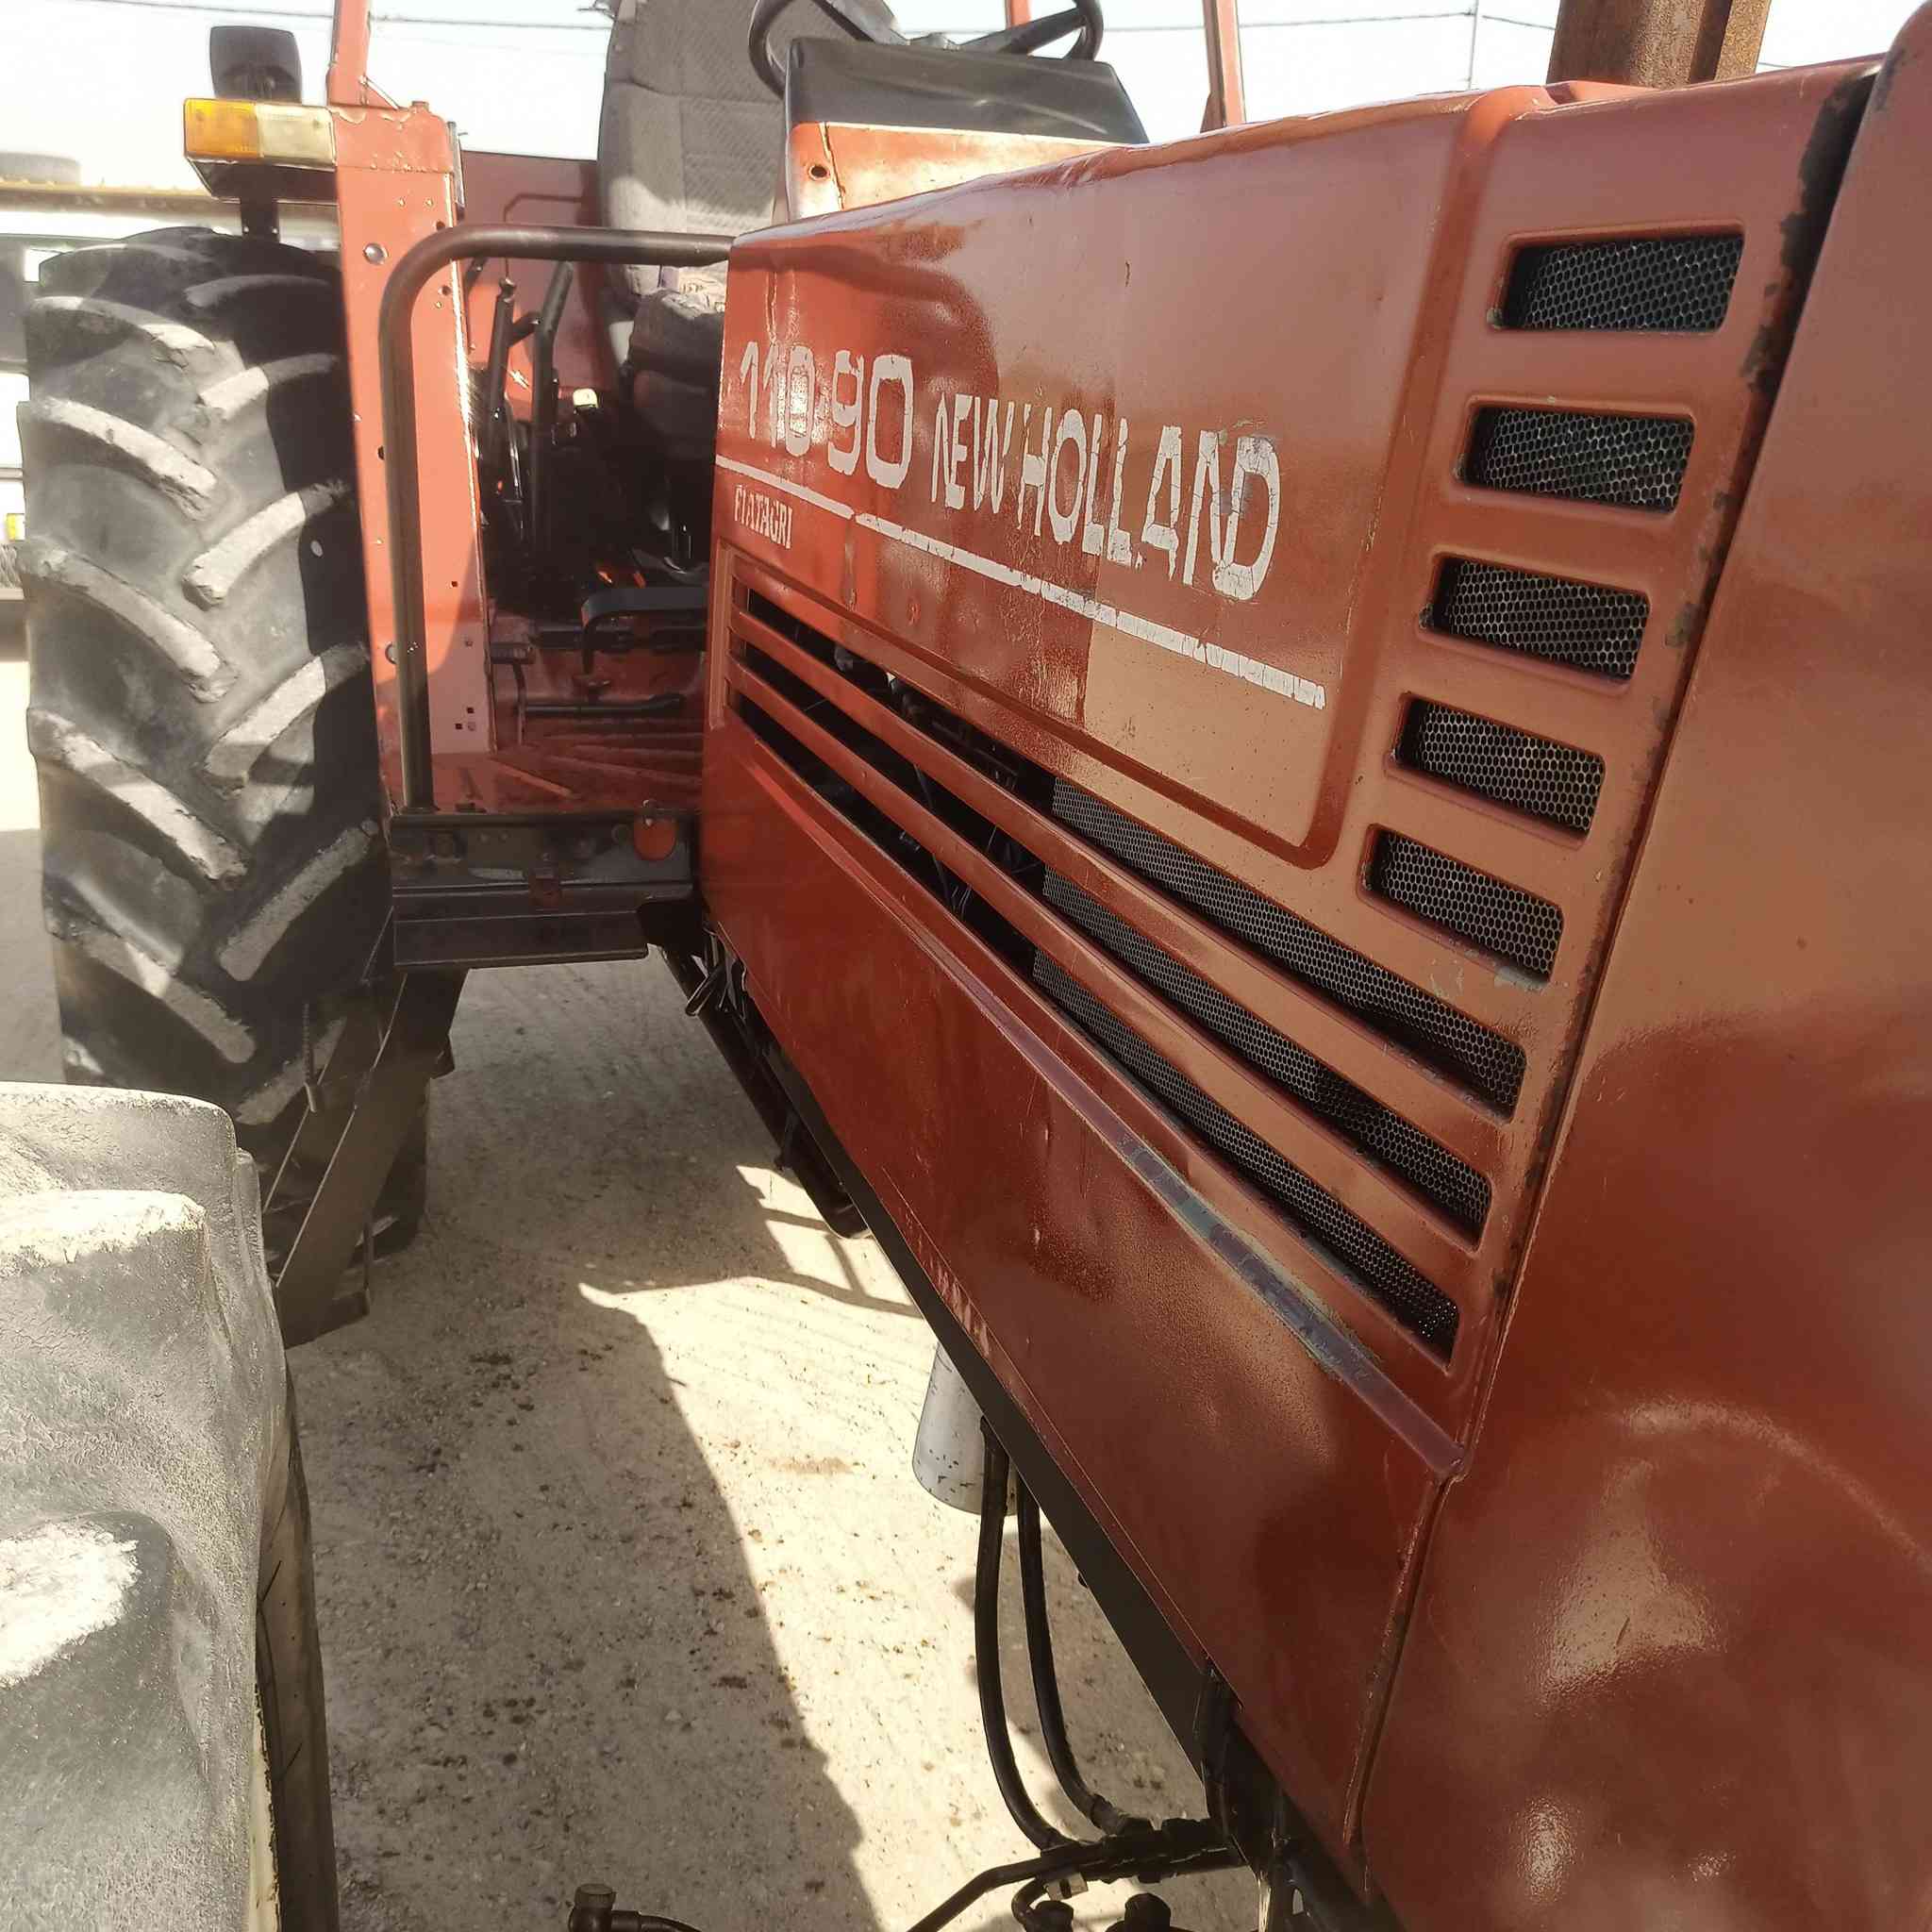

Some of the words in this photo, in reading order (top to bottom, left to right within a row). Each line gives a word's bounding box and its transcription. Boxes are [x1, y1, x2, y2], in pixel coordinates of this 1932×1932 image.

[734, 484, 793, 549] FIATAGRI
[931, 392, 1014, 514] NEW
[1018, 404, 1280, 601] HOLLAND
